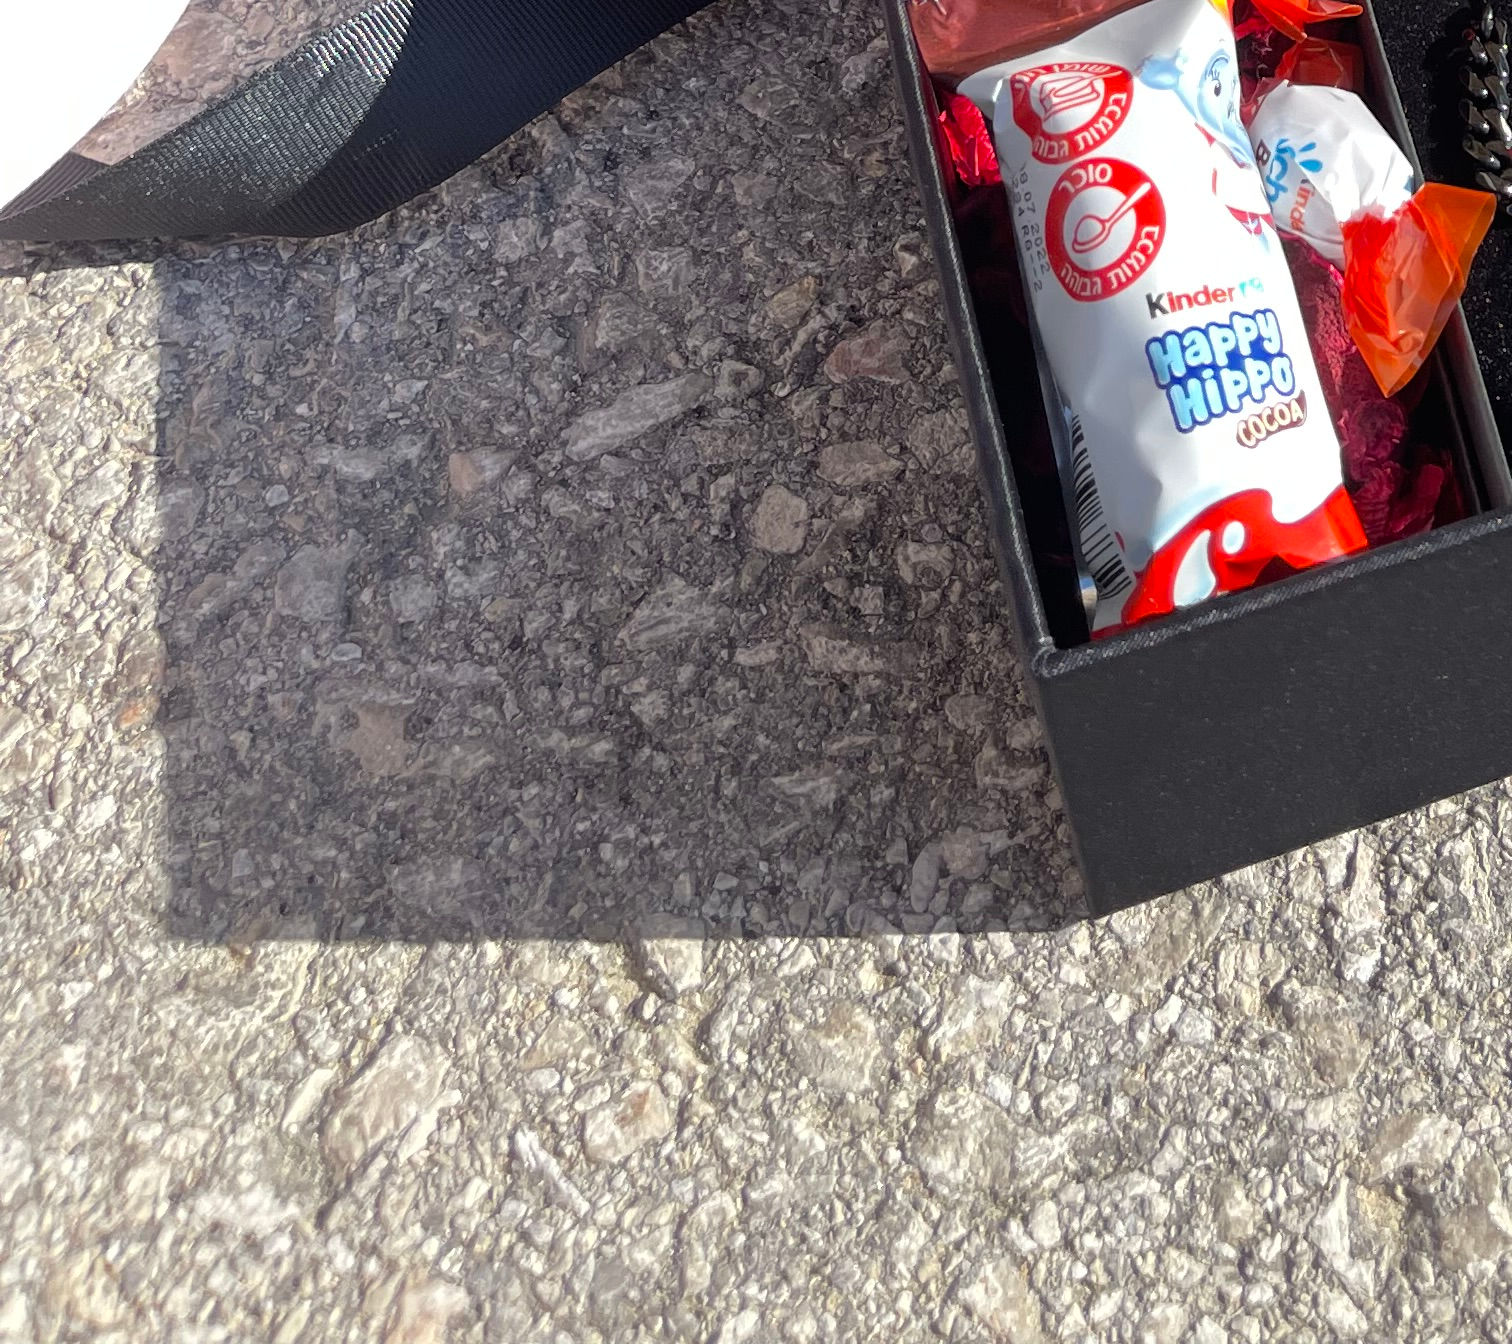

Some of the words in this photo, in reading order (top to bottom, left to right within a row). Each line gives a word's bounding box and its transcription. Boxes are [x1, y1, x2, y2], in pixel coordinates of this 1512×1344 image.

[1074, 92, 1128, 152] בכמות
[1059, 163, 1112, 194] סוכר
[1108, 225, 1160, 289] בכמות
[1060, 262, 1103, 297] גבוהה
[1145, 284, 1235, 319] Kinder
[1237, 398, 1306, 448] COCOA
